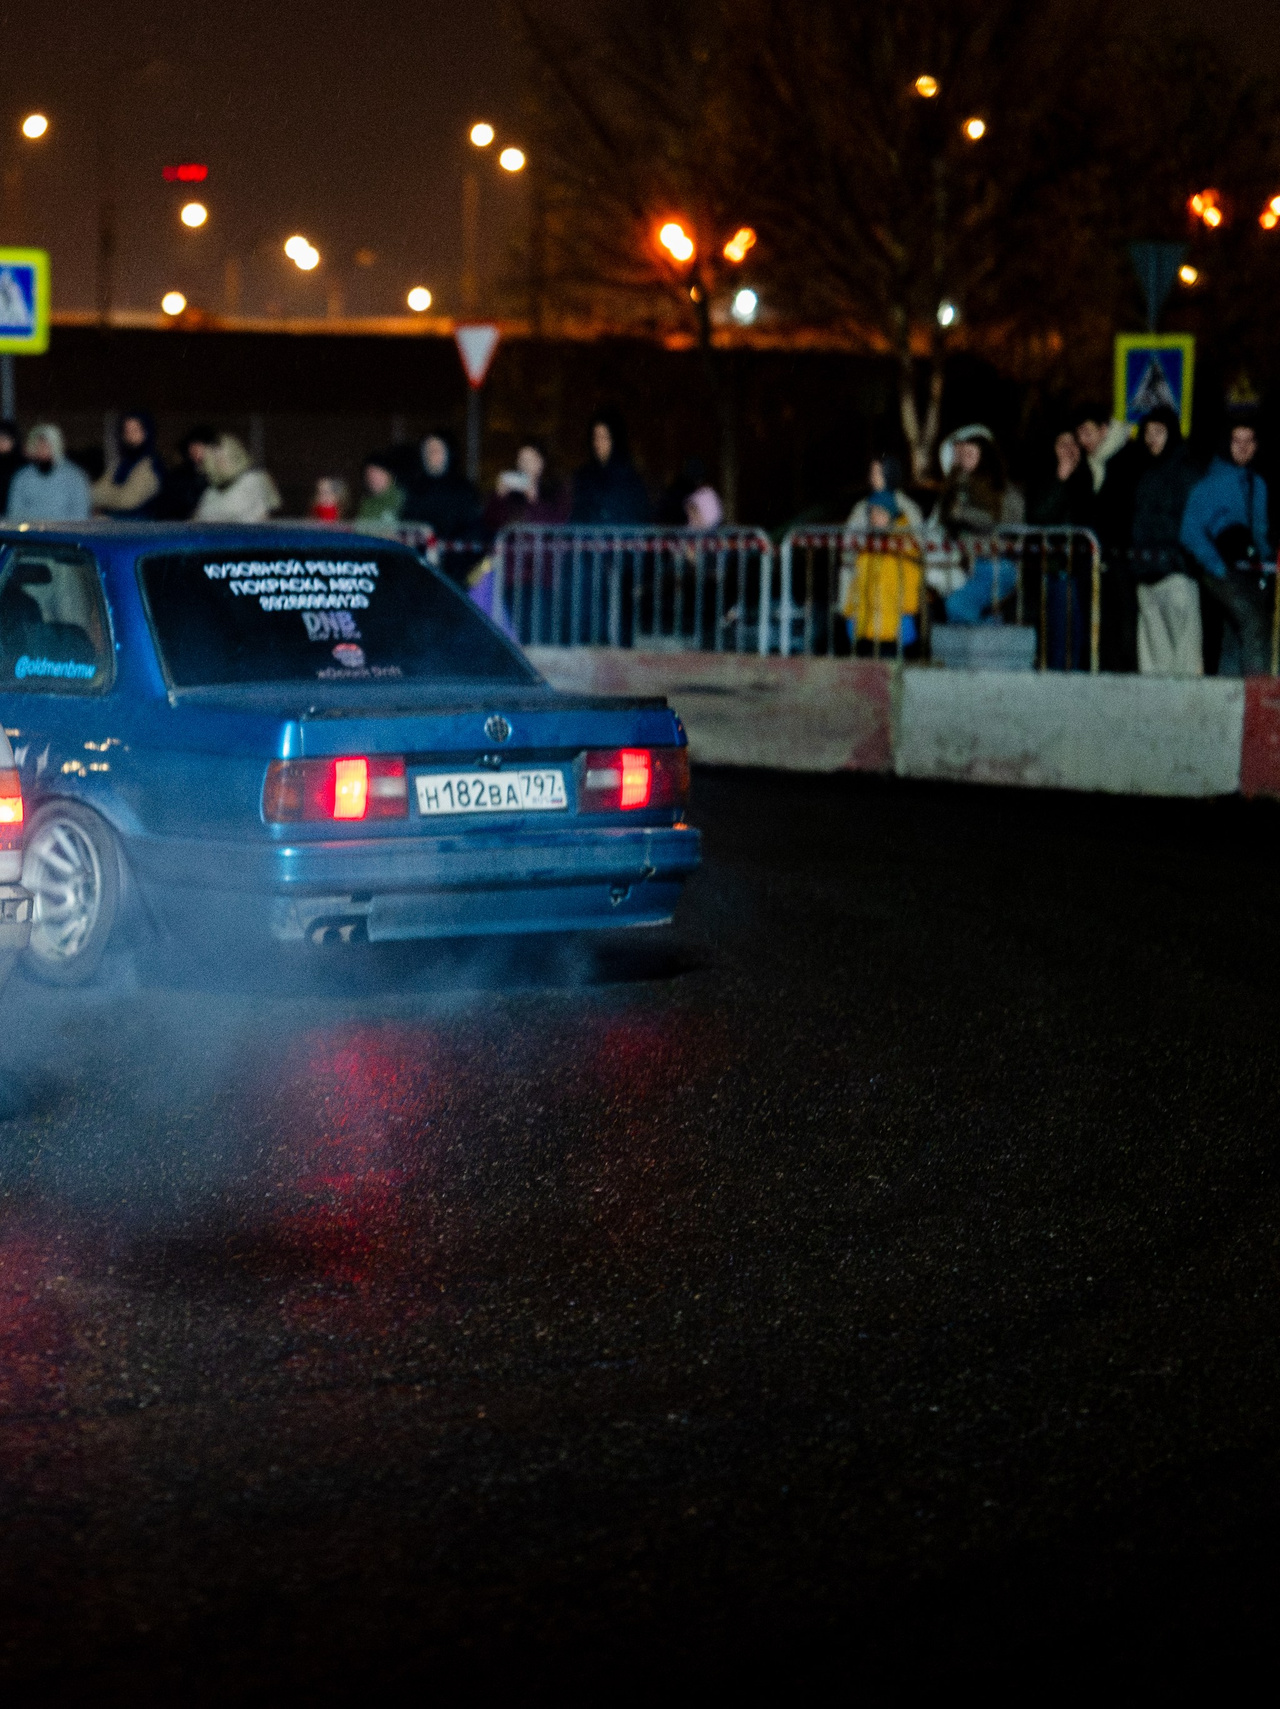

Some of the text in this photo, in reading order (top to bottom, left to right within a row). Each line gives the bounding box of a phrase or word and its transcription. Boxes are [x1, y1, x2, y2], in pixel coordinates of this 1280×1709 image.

[305, 560, 379, 578] РЕМОНТ
[229, 577, 376, 596] ПОКРАСКА АВТО
[425, 774, 556, 809] Н182ВА 797
